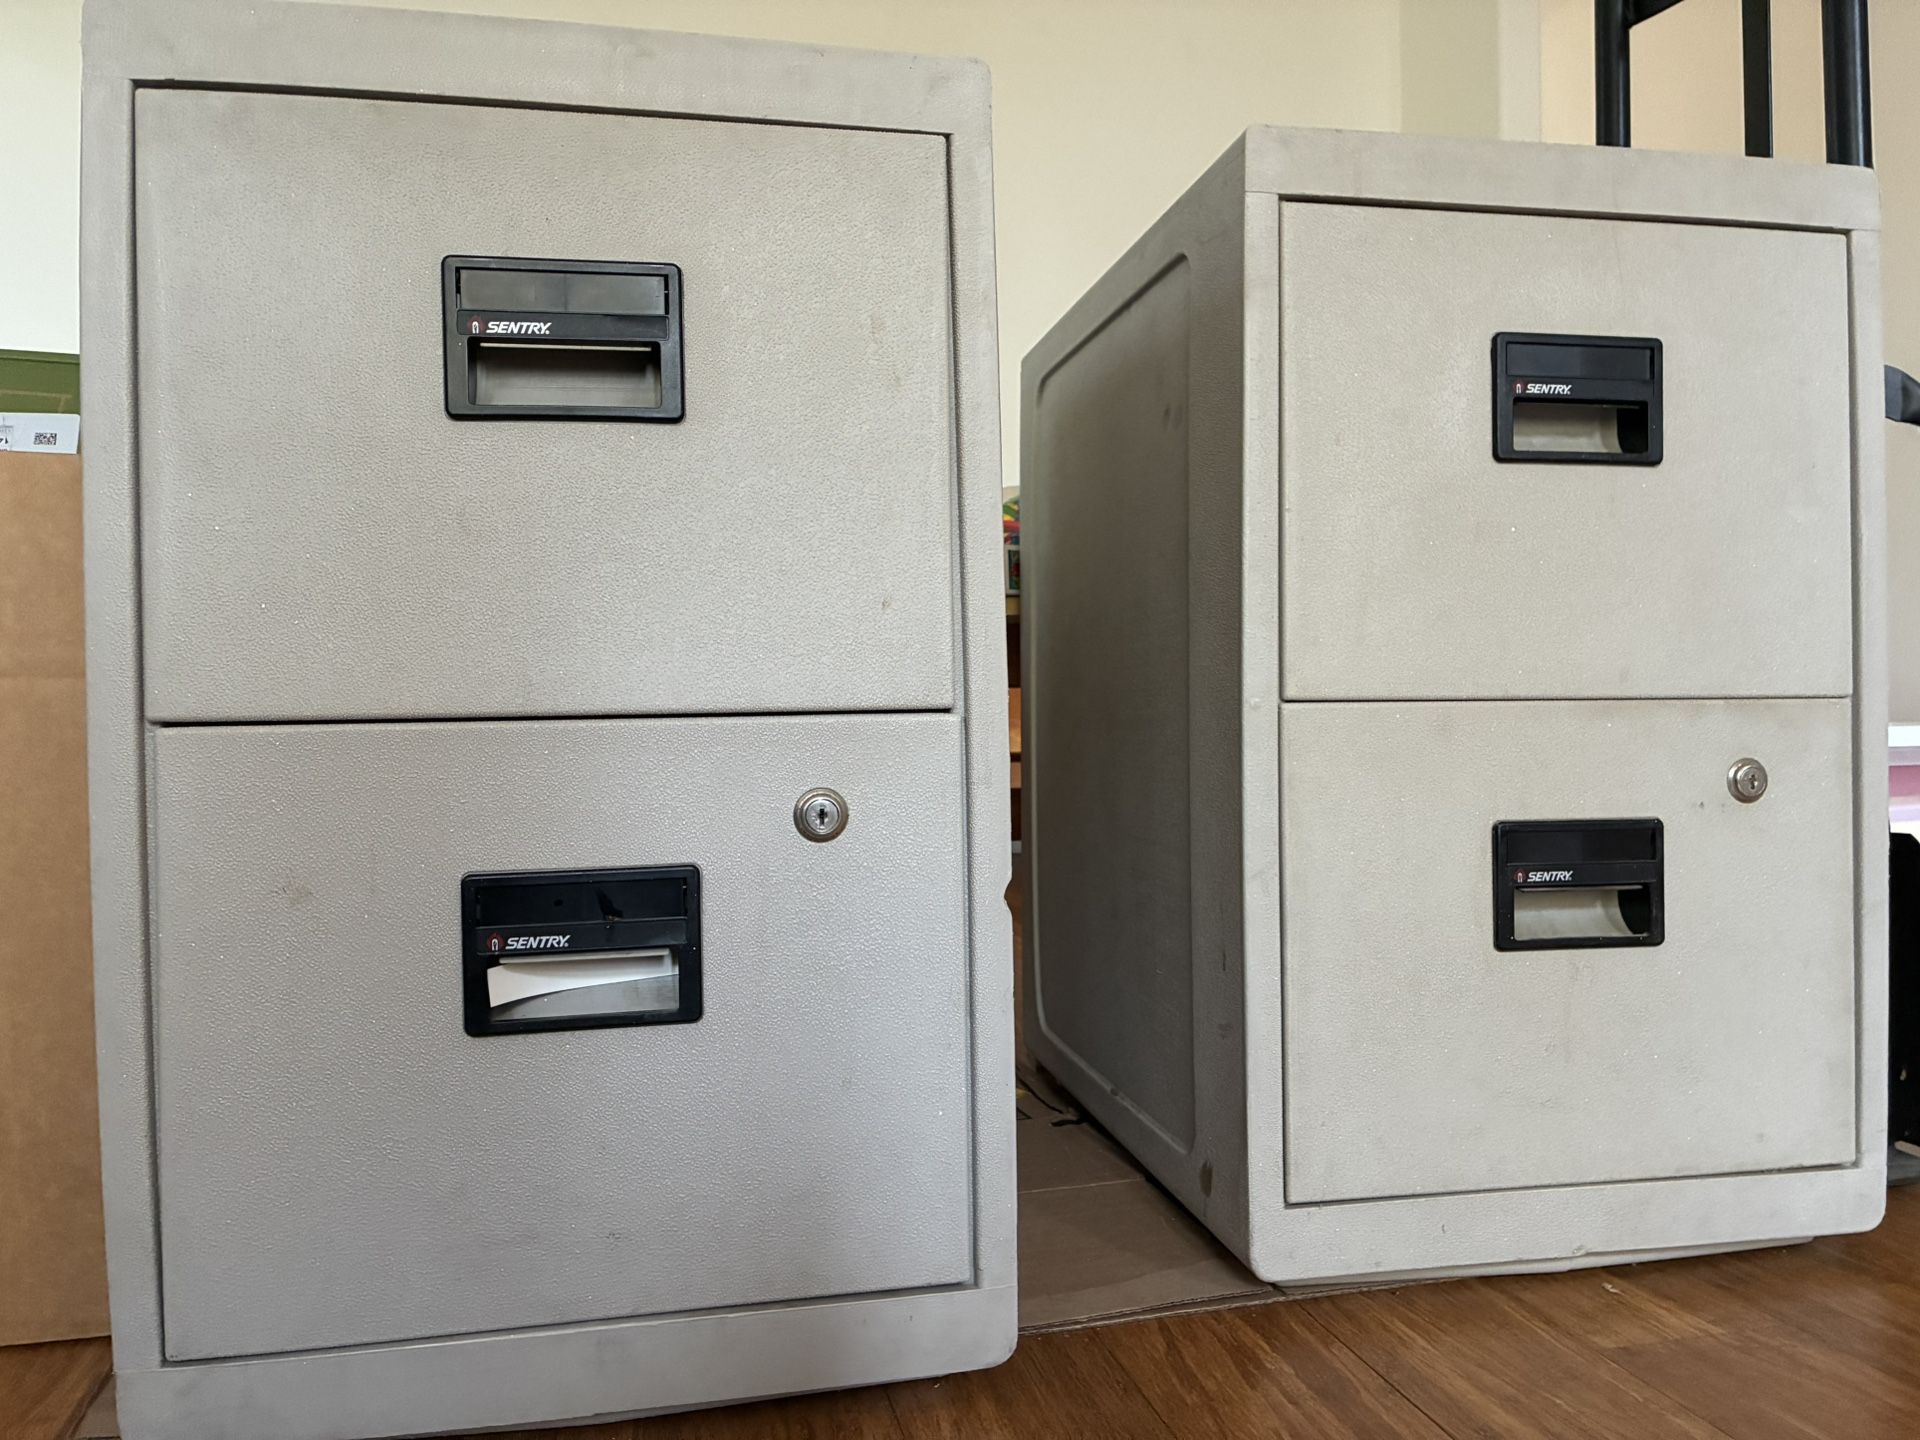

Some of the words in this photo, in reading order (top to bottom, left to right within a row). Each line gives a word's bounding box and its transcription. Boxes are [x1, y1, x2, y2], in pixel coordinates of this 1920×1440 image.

[486, 321, 552, 335] SENTRY
[1526, 383, 1572, 395] SENTRY
[1527, 870, 1574, 882] SENTRY
[505, 934, 571, 950] SENTRY
